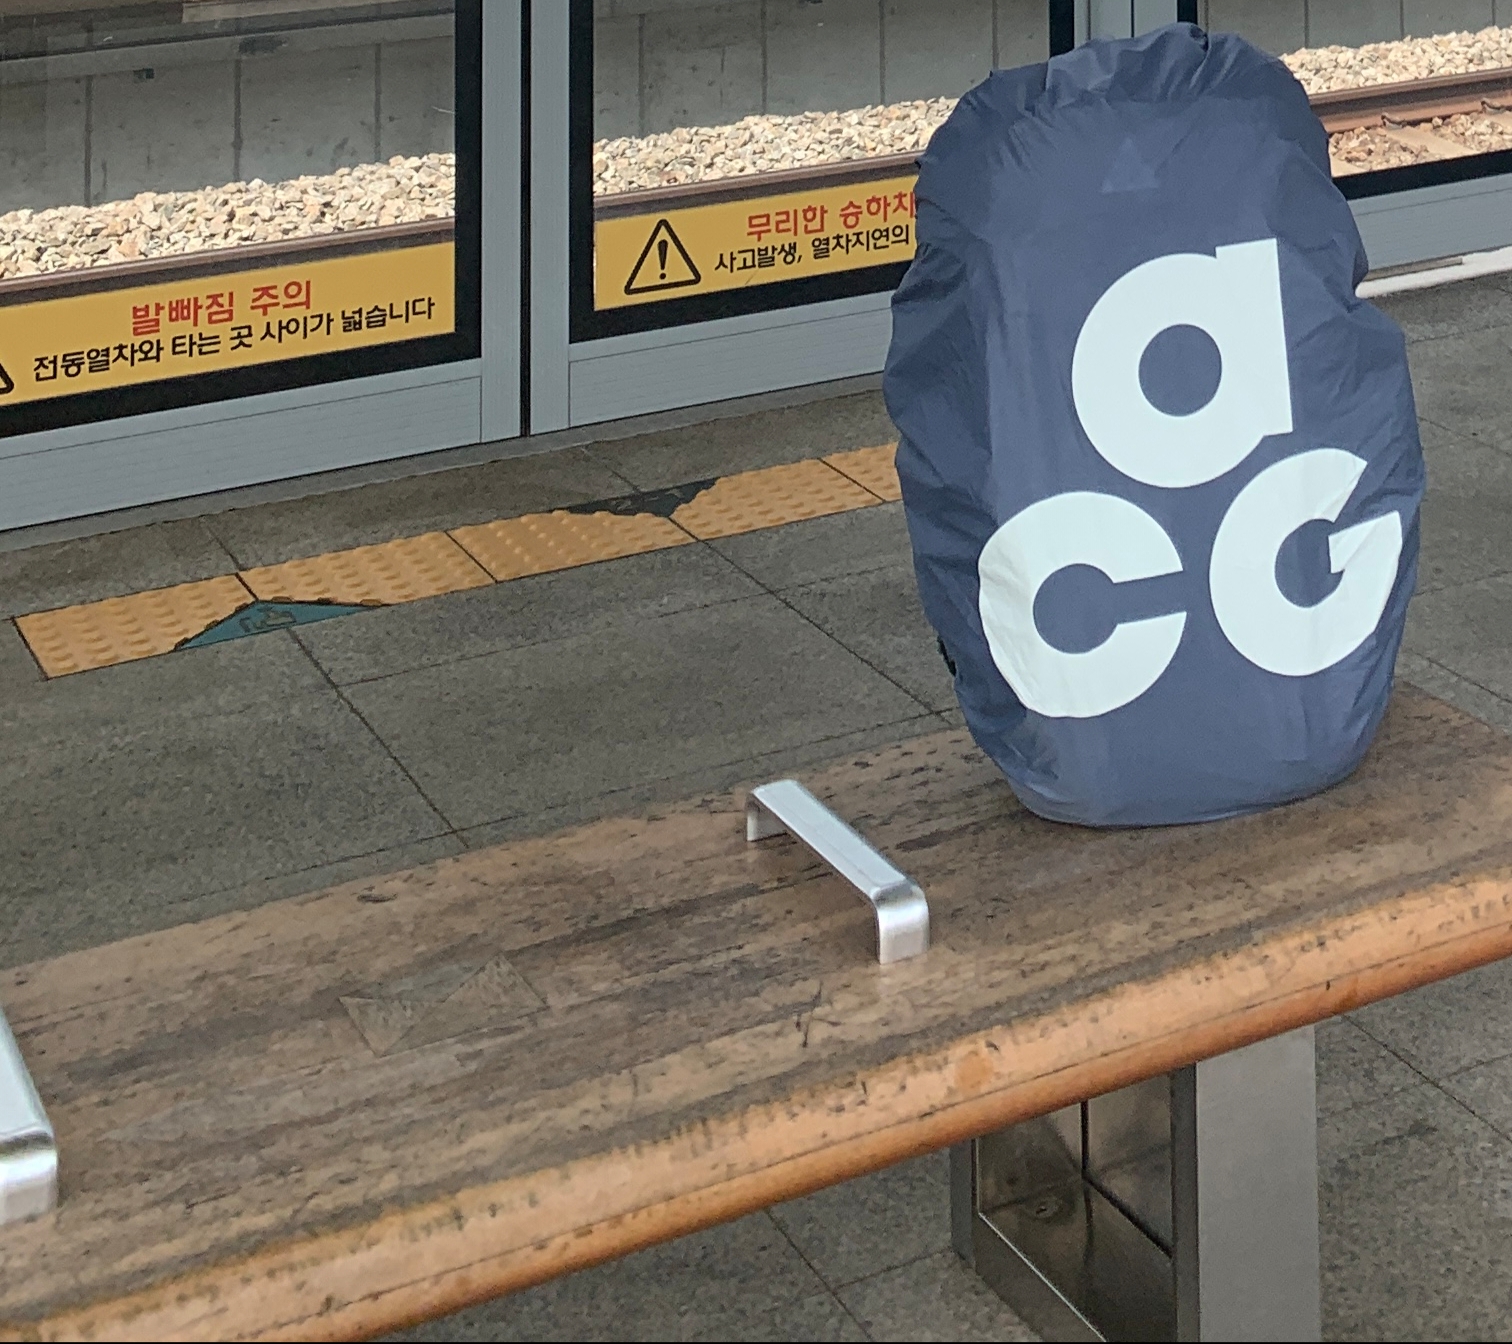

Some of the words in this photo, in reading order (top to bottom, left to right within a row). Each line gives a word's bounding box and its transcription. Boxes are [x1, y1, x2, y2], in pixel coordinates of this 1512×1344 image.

[714, 242, 802, 274] 사고발생,
[811, 223, 910, 259] 열차지연의
[747, 204, 828, 243] 무리한
[131, 290, 235, 336] 발빠짐
[249, 279, 312, 313] 주의
[33, 338, 165, 383] 전동열차와
[171, 330, 222, 360] 타는
[228, 325, 254, 350] 곳
[261, 310, 335, 344] 사이가
[341, 295, 436, 333] 넓습니다
